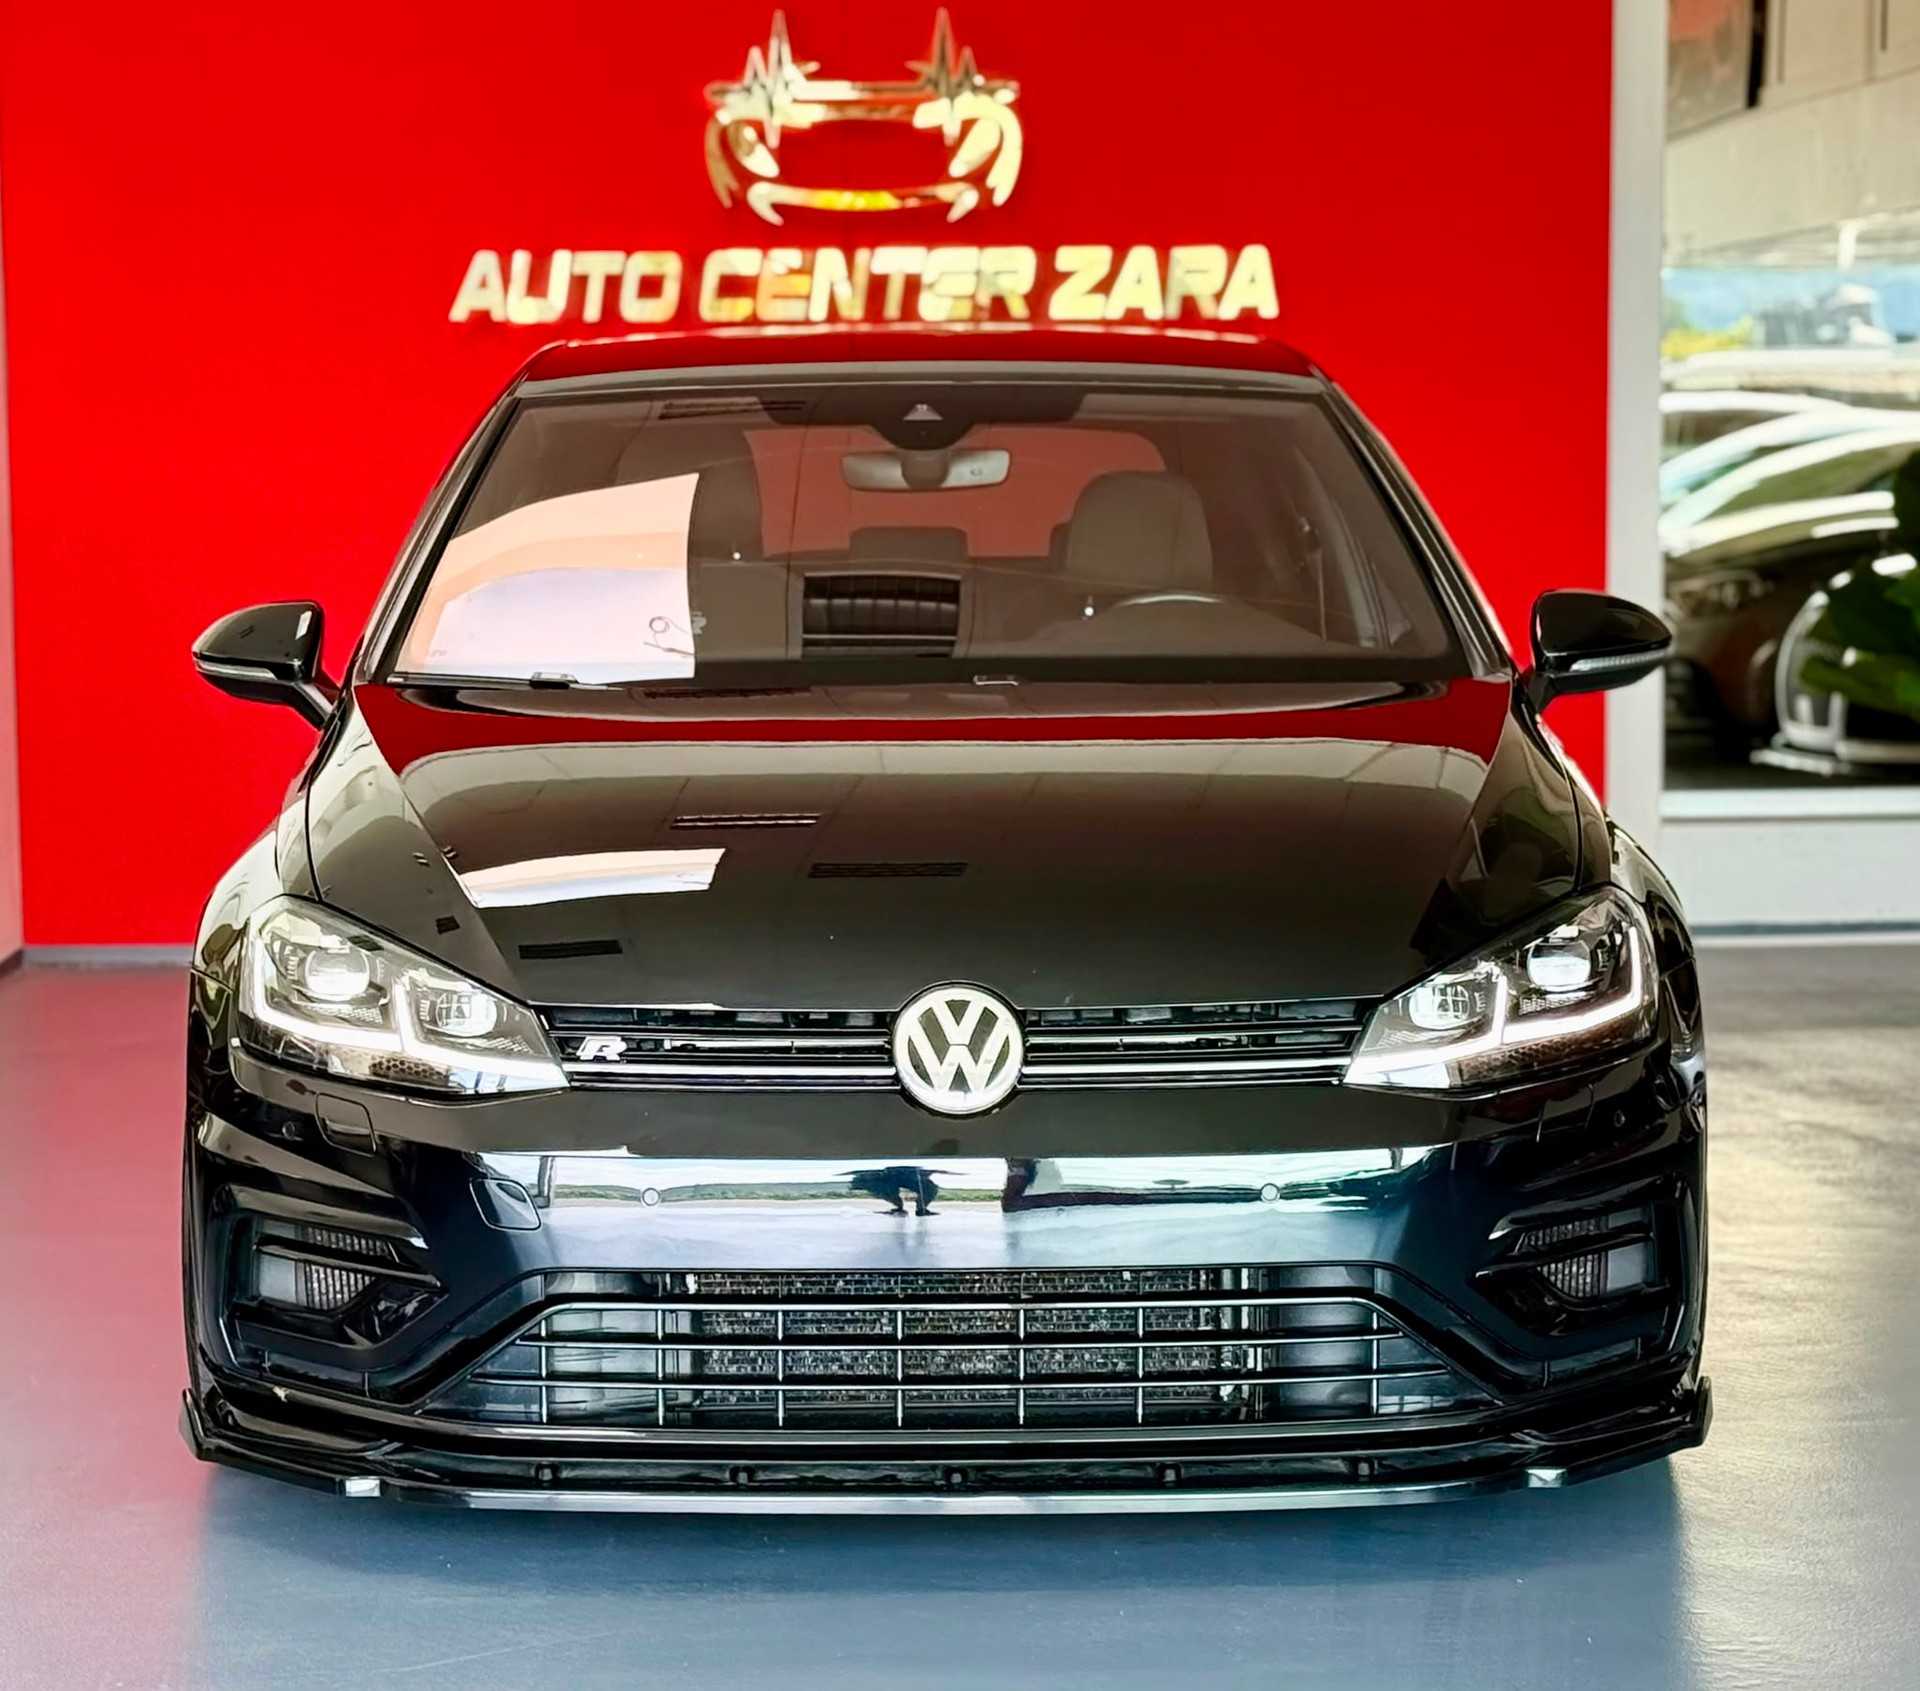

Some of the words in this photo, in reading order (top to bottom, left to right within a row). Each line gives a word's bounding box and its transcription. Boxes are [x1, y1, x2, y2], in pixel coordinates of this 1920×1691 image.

[448, 248, 681, 324] AUTO
[698, 246, 1032, 324] CENTER
[1047, 244, 1281, 323] ZARA
[575, 1035, 628, 1064] R
[899, 990, 1021, 1104] VW
